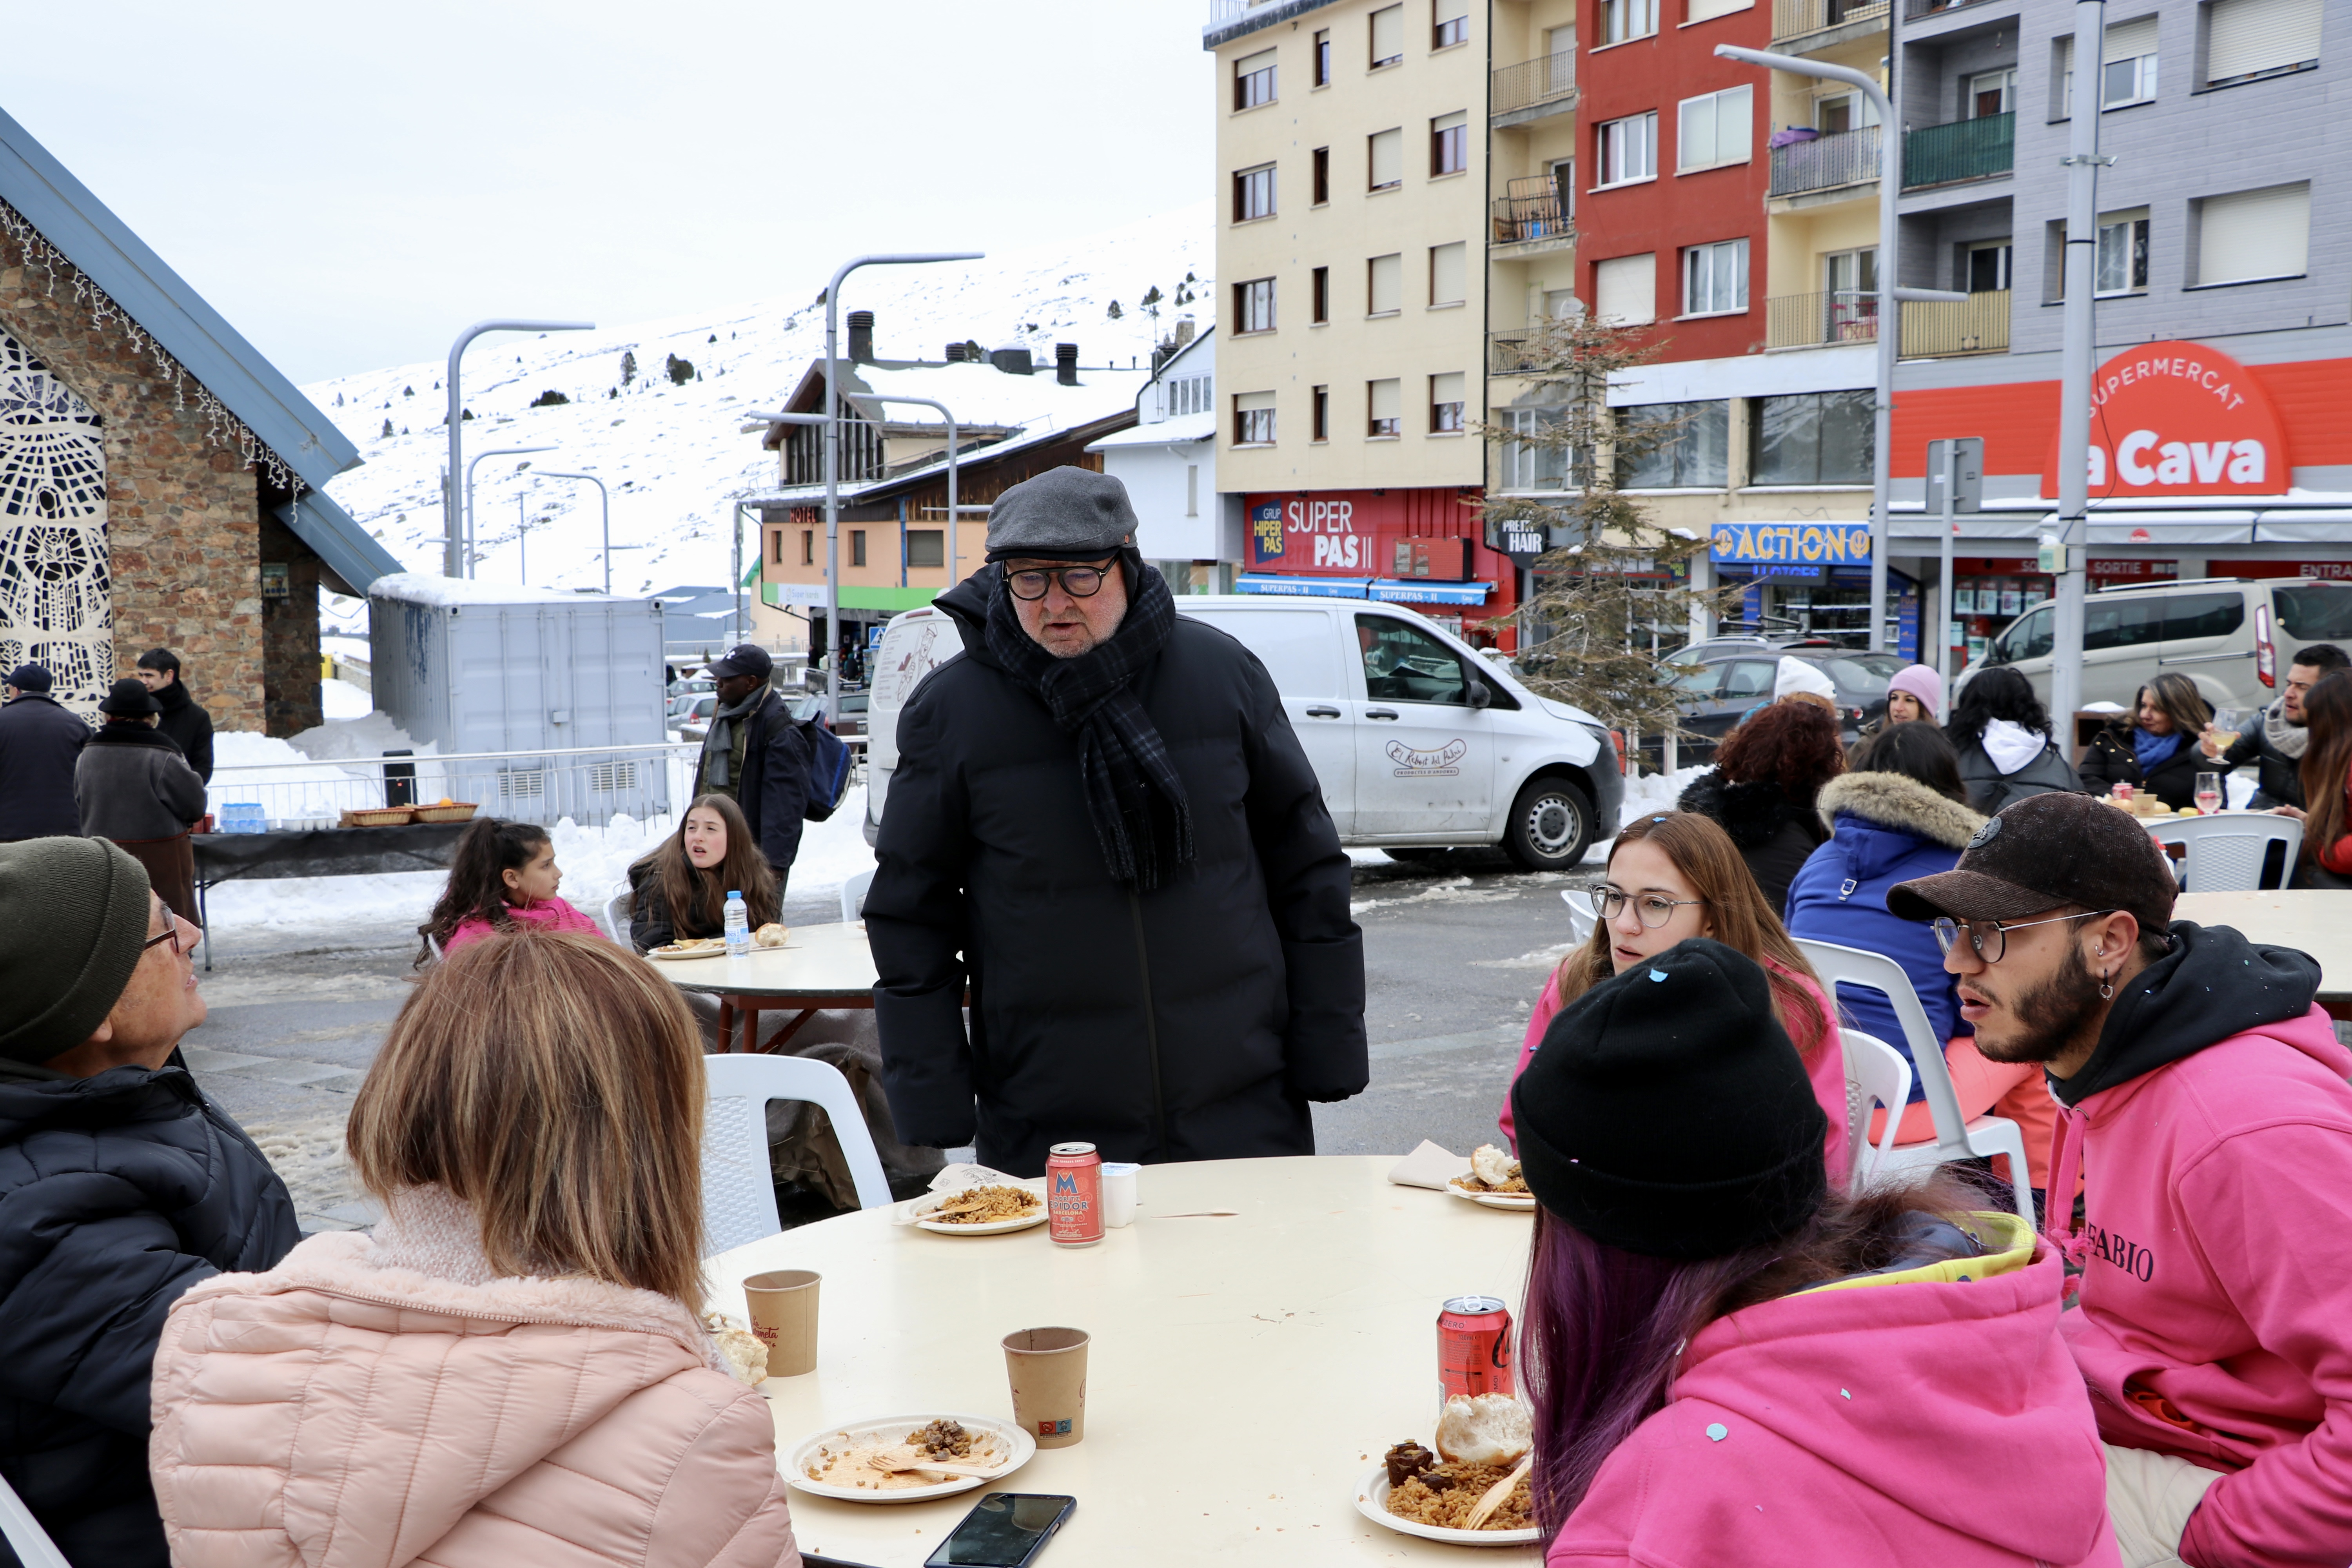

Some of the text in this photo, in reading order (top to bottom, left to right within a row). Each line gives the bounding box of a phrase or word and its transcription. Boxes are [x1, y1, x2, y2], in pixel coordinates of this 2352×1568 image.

[2117, 429, 2266, 486] Cava
[790, 506, 816, 523] HOTEL
[1263, 508, 1281, 519] GRUP
[1288, 500, 1353, 533] SUPER
[1254, 521, 1282, 536] HIPER
[1263, 536, 1282, 554] PAS
[1314, 534, 1359, 568] PAS
[1362, 536, 1372, 569] II
[1509, 533, 1542, 553] HAIR
[1737, 525, 1846, 561] ACTION
[2094, 562, 2141, 574] SORTIE
[1261, 584, 1296, 593] SUPERPAS
[1380, 591, 1423, 600] SUPERPAS
[1392, 744, 1403, 760] El
[1405, 750, 1429, 767] Rebost
[1432, 755, 1440, 766] del
[1054, 1171, 1078, 1194] M
[1050, 1200, 1089, 1210] EPIDOR
[2088, 1221, 2154, 1282] FABIO
[753, 1315, 763, 1329] La
